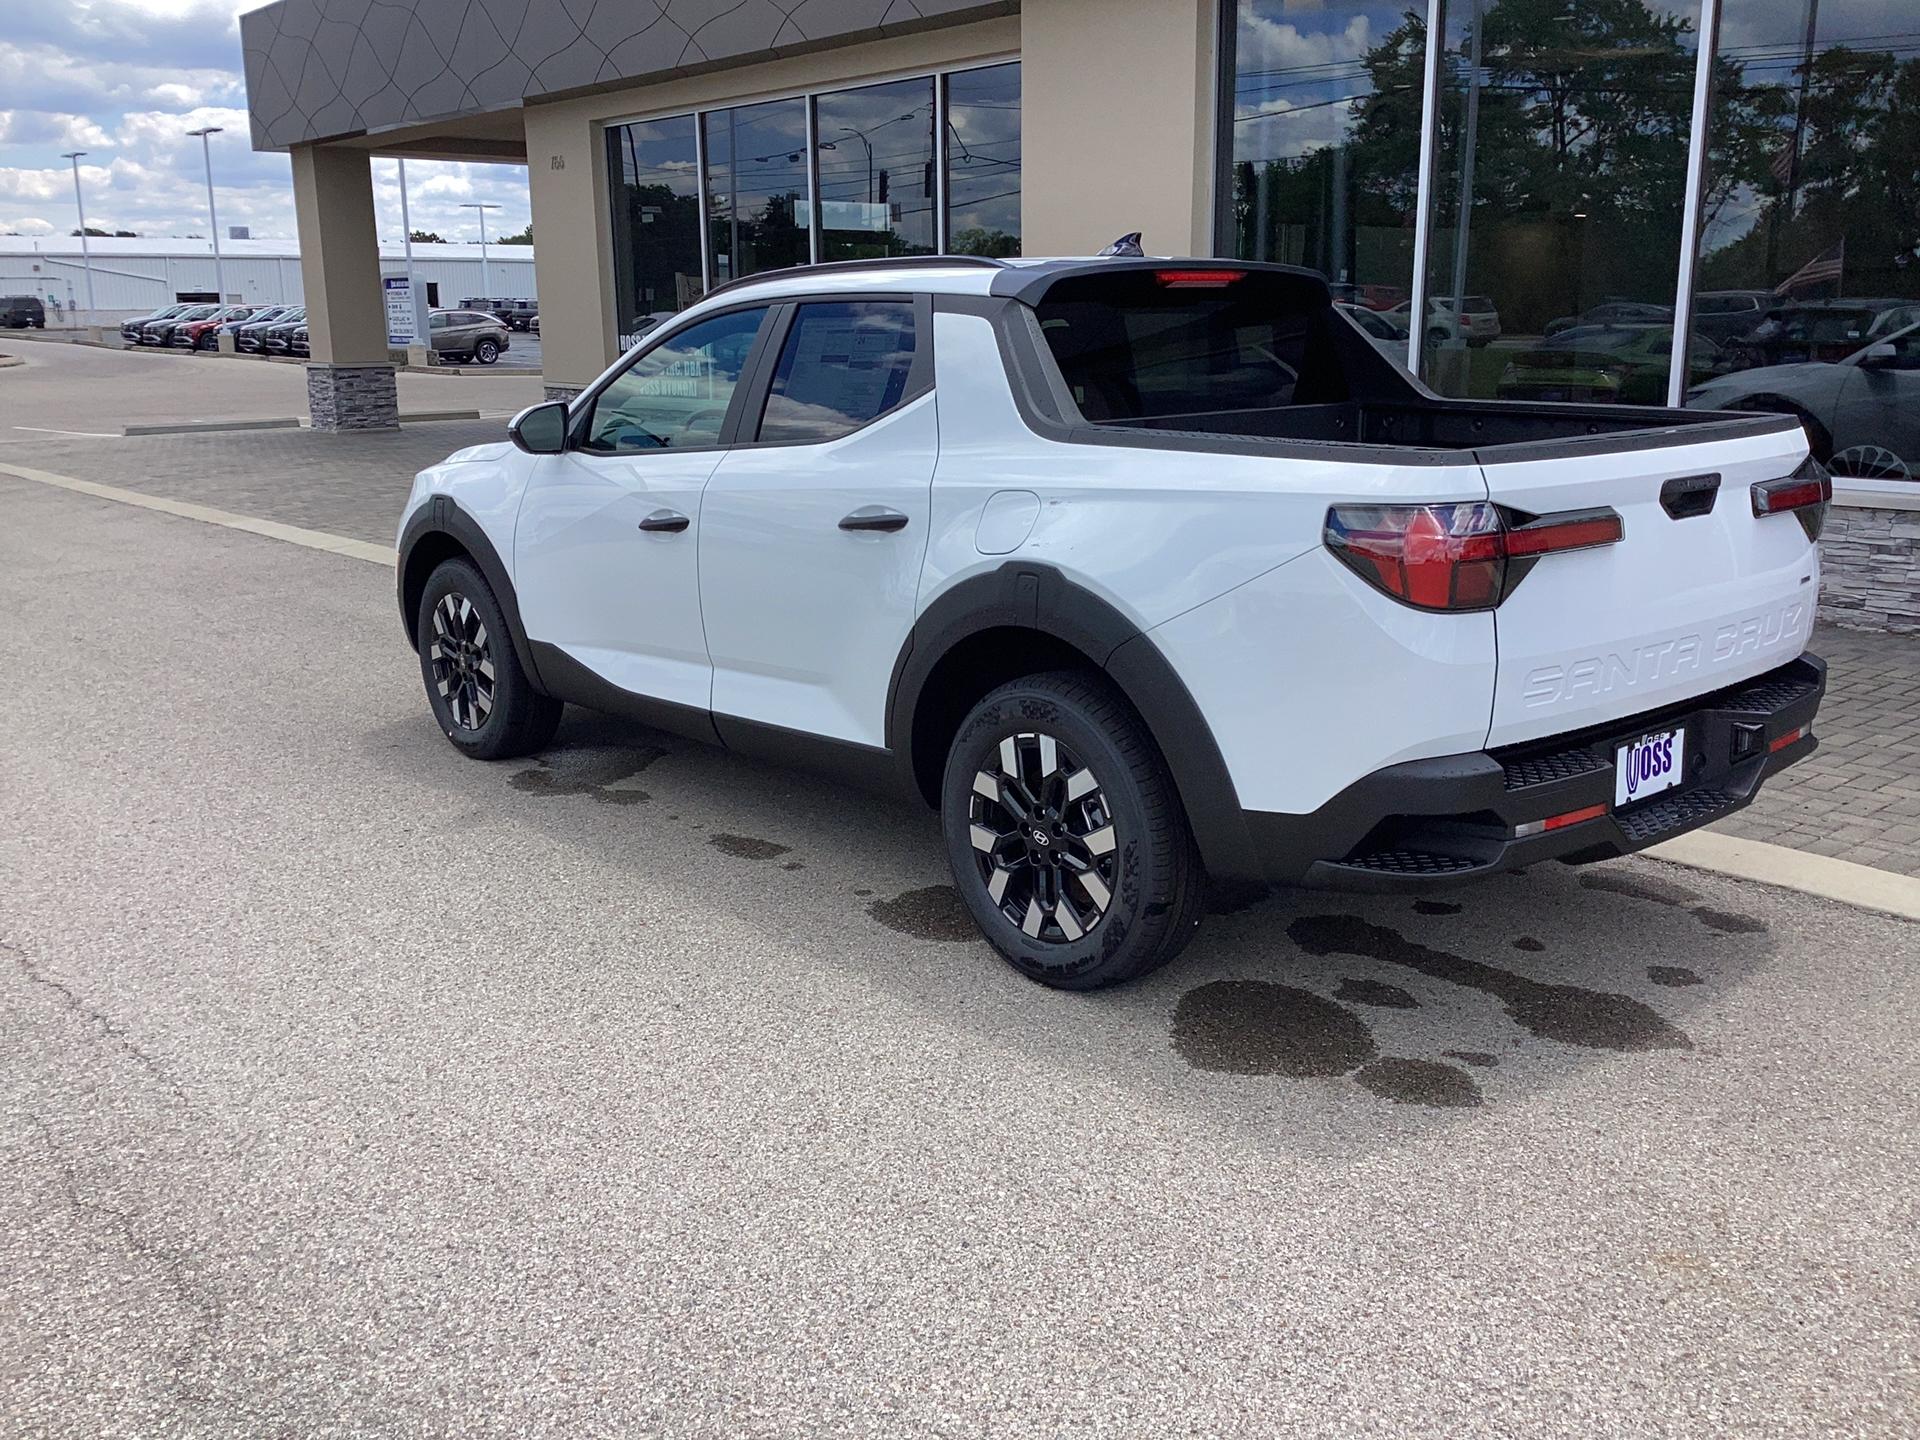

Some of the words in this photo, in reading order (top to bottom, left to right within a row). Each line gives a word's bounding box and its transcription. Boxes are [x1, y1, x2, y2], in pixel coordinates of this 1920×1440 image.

[684, 360, 701, 377] DBA
[661, 379, 697, 397] HYUNDAI
[1523, 633, 1702, 708] SANTA
[1712, 603, 1803, 663] CRUZ
[1626, 737, 1672, 795] VOSS
